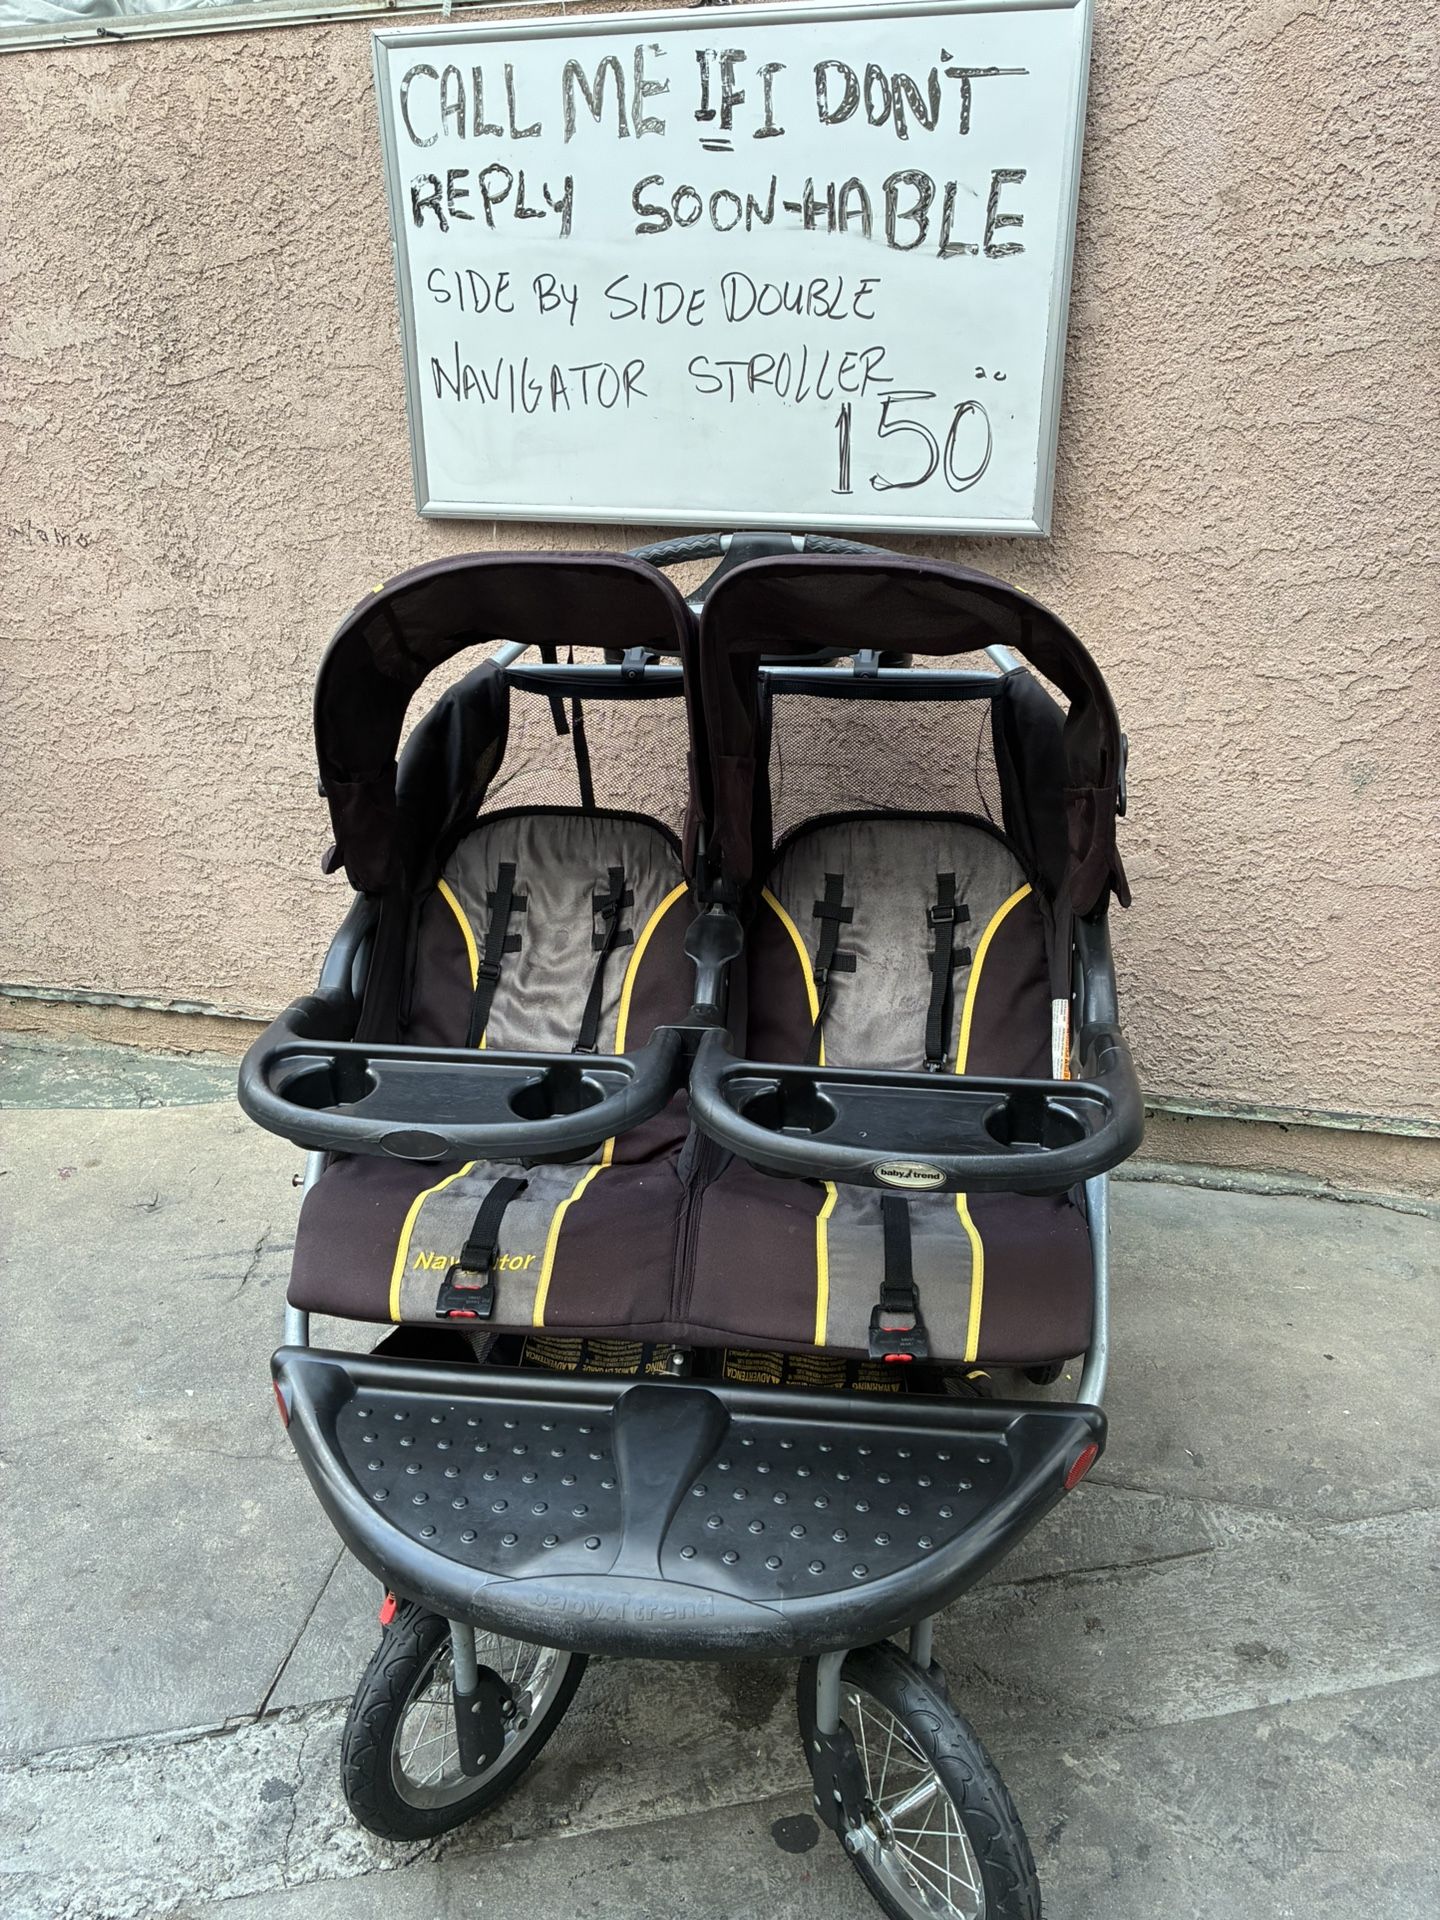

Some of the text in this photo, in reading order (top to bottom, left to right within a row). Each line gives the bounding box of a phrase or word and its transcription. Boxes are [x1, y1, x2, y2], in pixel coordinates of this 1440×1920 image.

[400, 61, 544, 147] CALL
[562, 43, 670, 144] ME
[694, 48, 748, 132] IF
[753, 61, 786, 140] I
[410, 162, 574, 239] REPLY
[426, 268, 516, 313] SIDE
[605, 274, 705, 327] SIDE
[720, 271, 881, 324] DOUBLE
[430, 341, 895, 415] NAVIGATOR STROLLER
[831, 390, 993, 494] 150
[880, 1168, 941, 1180] baby trend
[413, 1251, 536, 1271] Navtor
[726, 1367, 772, 1383] ADVERTENCIA
